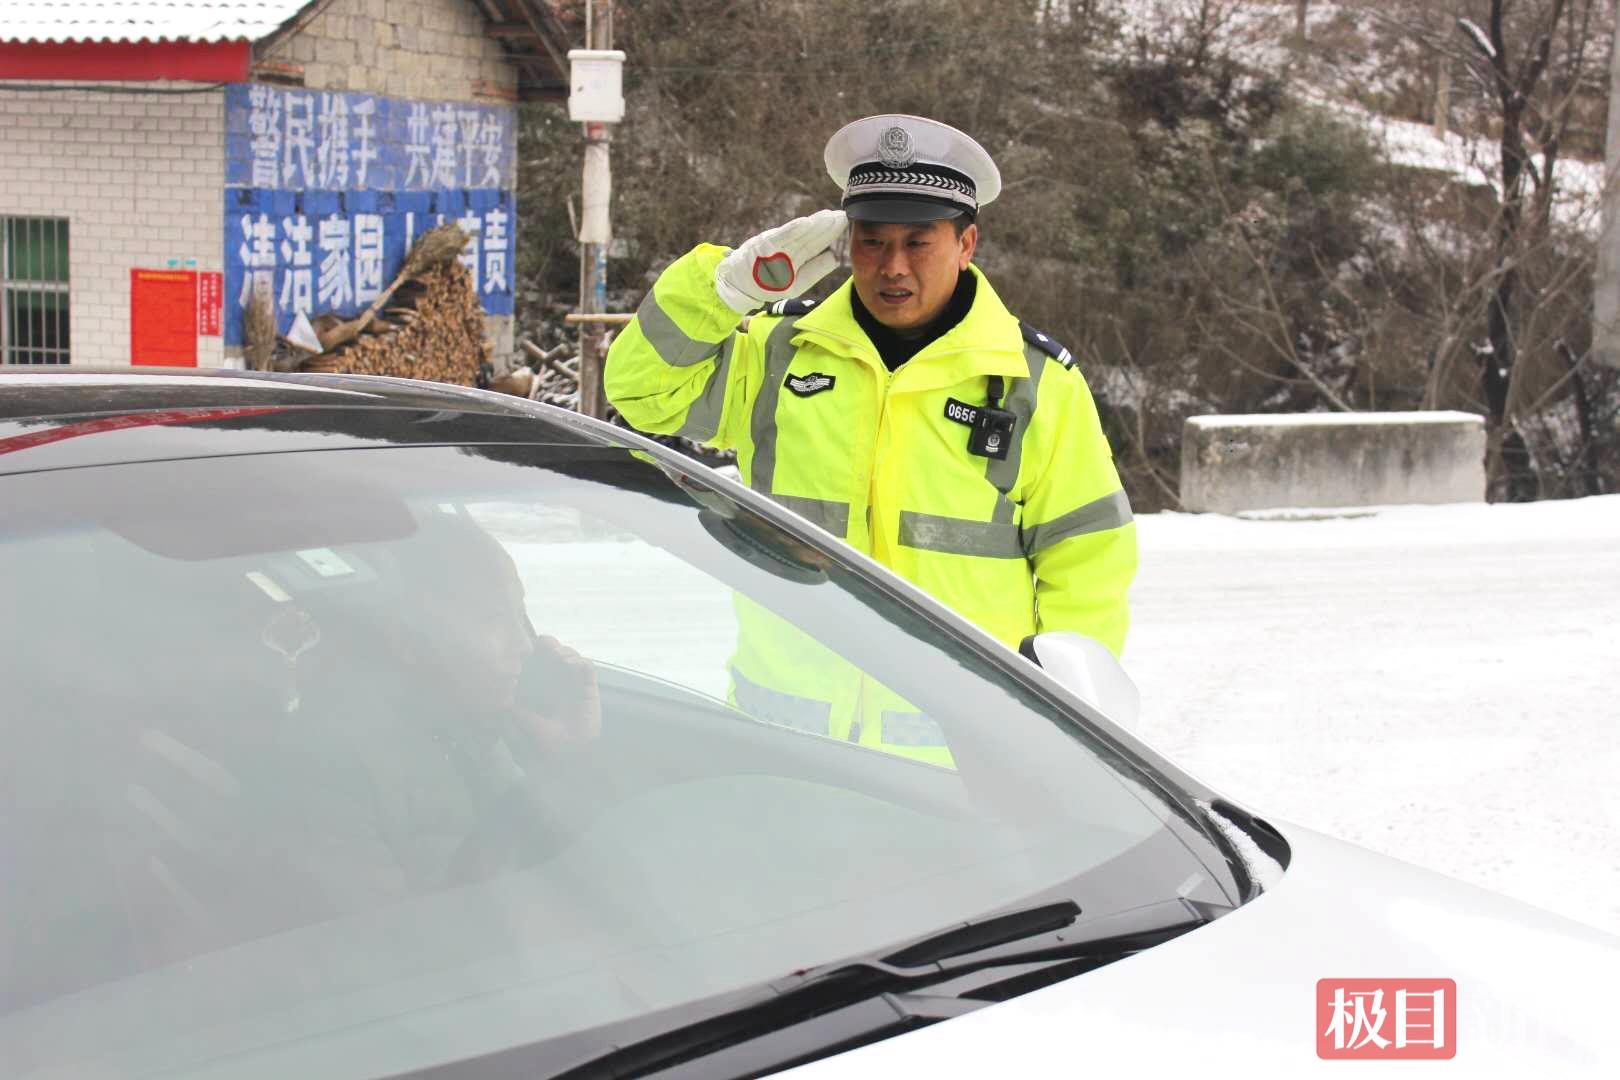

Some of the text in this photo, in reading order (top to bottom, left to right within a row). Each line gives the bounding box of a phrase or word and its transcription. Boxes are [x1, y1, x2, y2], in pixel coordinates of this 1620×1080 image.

[248, 85, 503, 190] 警民携手 共建平安
